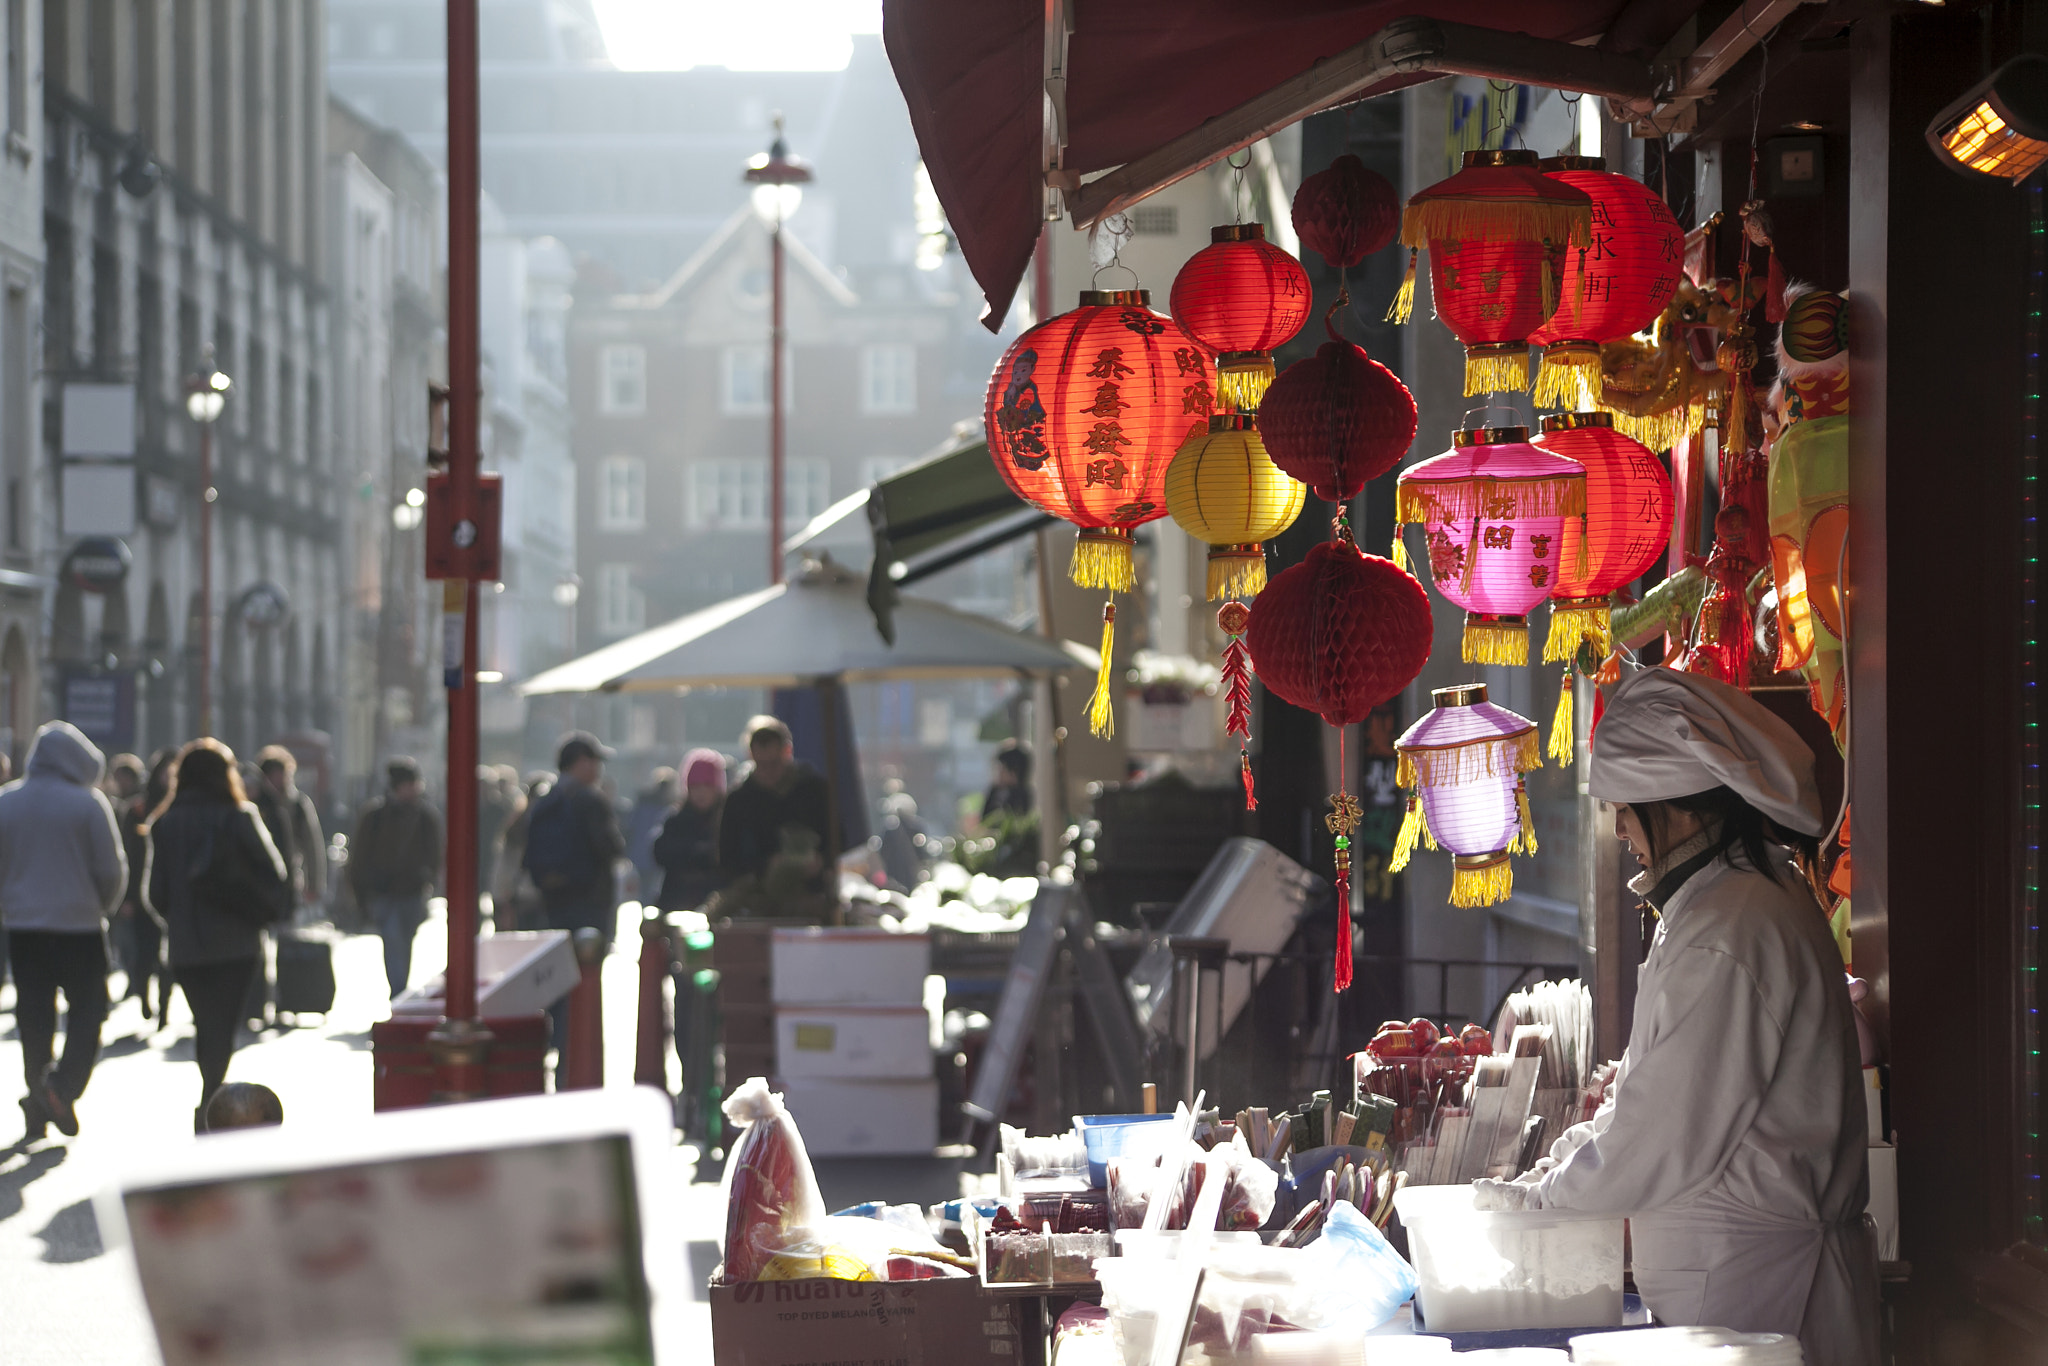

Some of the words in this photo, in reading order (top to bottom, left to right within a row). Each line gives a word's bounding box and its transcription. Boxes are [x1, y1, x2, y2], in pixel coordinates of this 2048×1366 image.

[1646, 198, 1679, 306] 風水軒
[1081, 346, 1134, 490] 恭喜發財
[1625, 455, 1661, 566] 風水軒
[1528, 534, 1552, 588] 富貴
[775, 1279, 864, 1302] huafu
[777, 1312, 799, 1321] TOP
[801, 1311, 829, 1320] DYED
[886, 1306, 915, 1317] YARN
